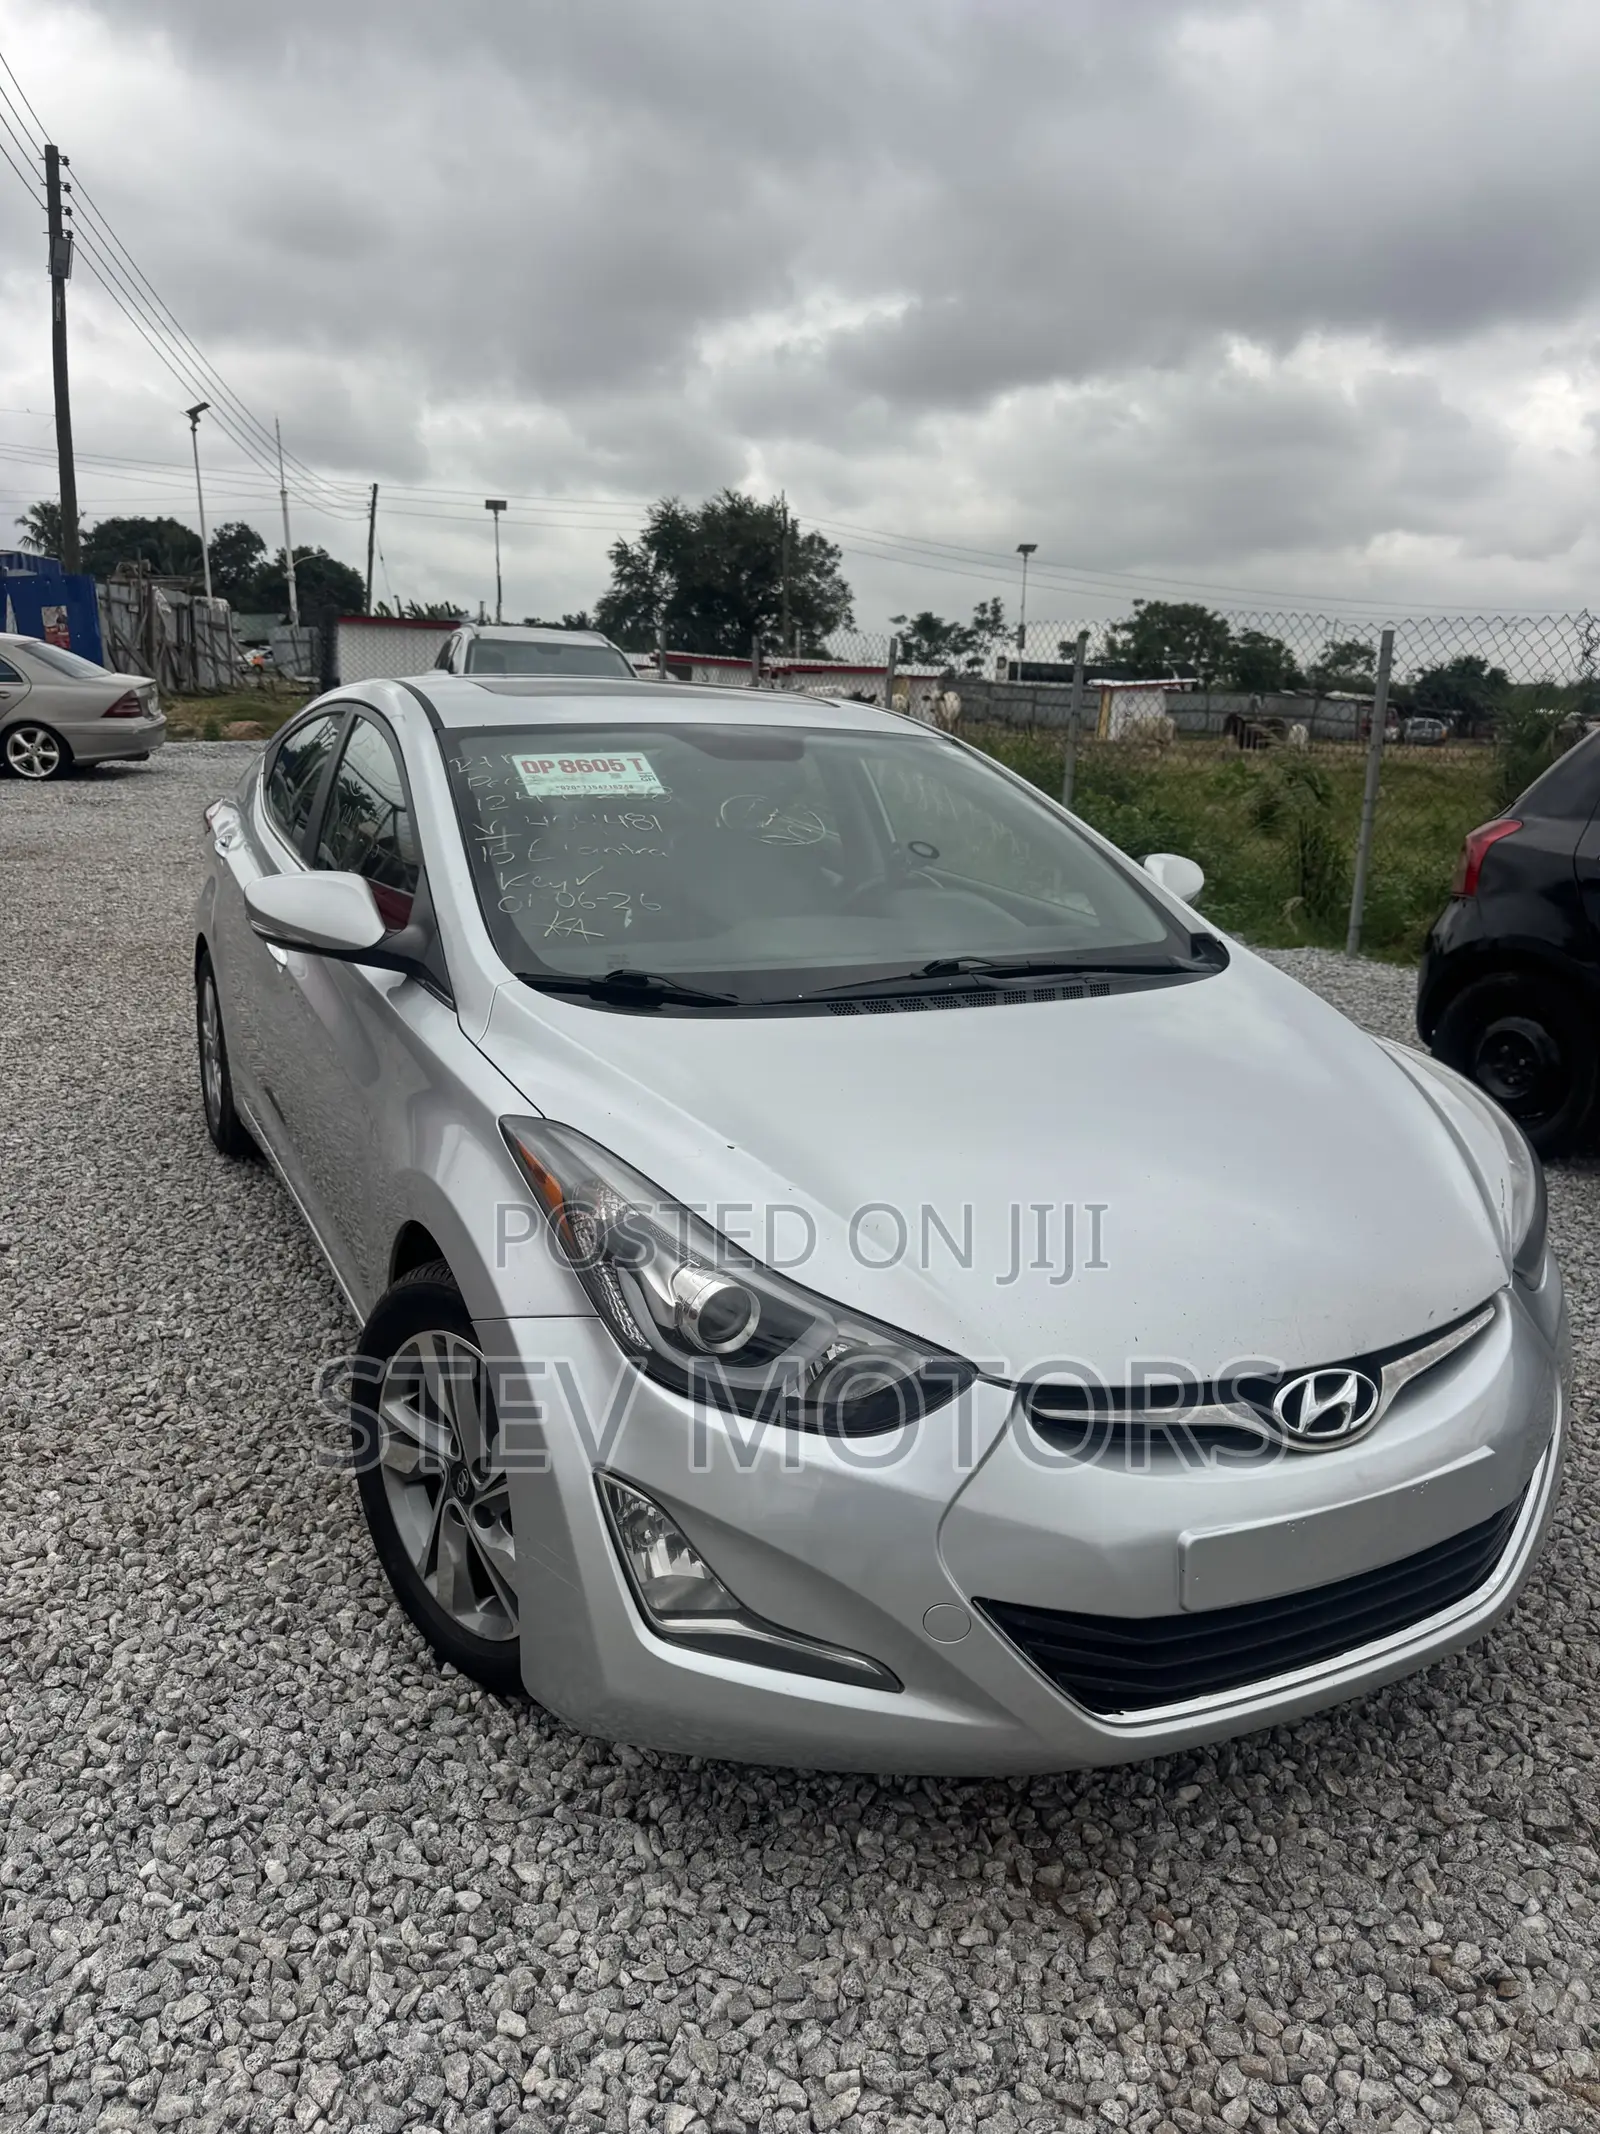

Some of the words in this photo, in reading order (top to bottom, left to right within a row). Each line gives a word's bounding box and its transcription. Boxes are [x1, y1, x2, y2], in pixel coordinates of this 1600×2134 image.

[521, 760, 555, 774] DP
[557, 758, 626, 773] 8605
[627, 758, 643, 772] T
